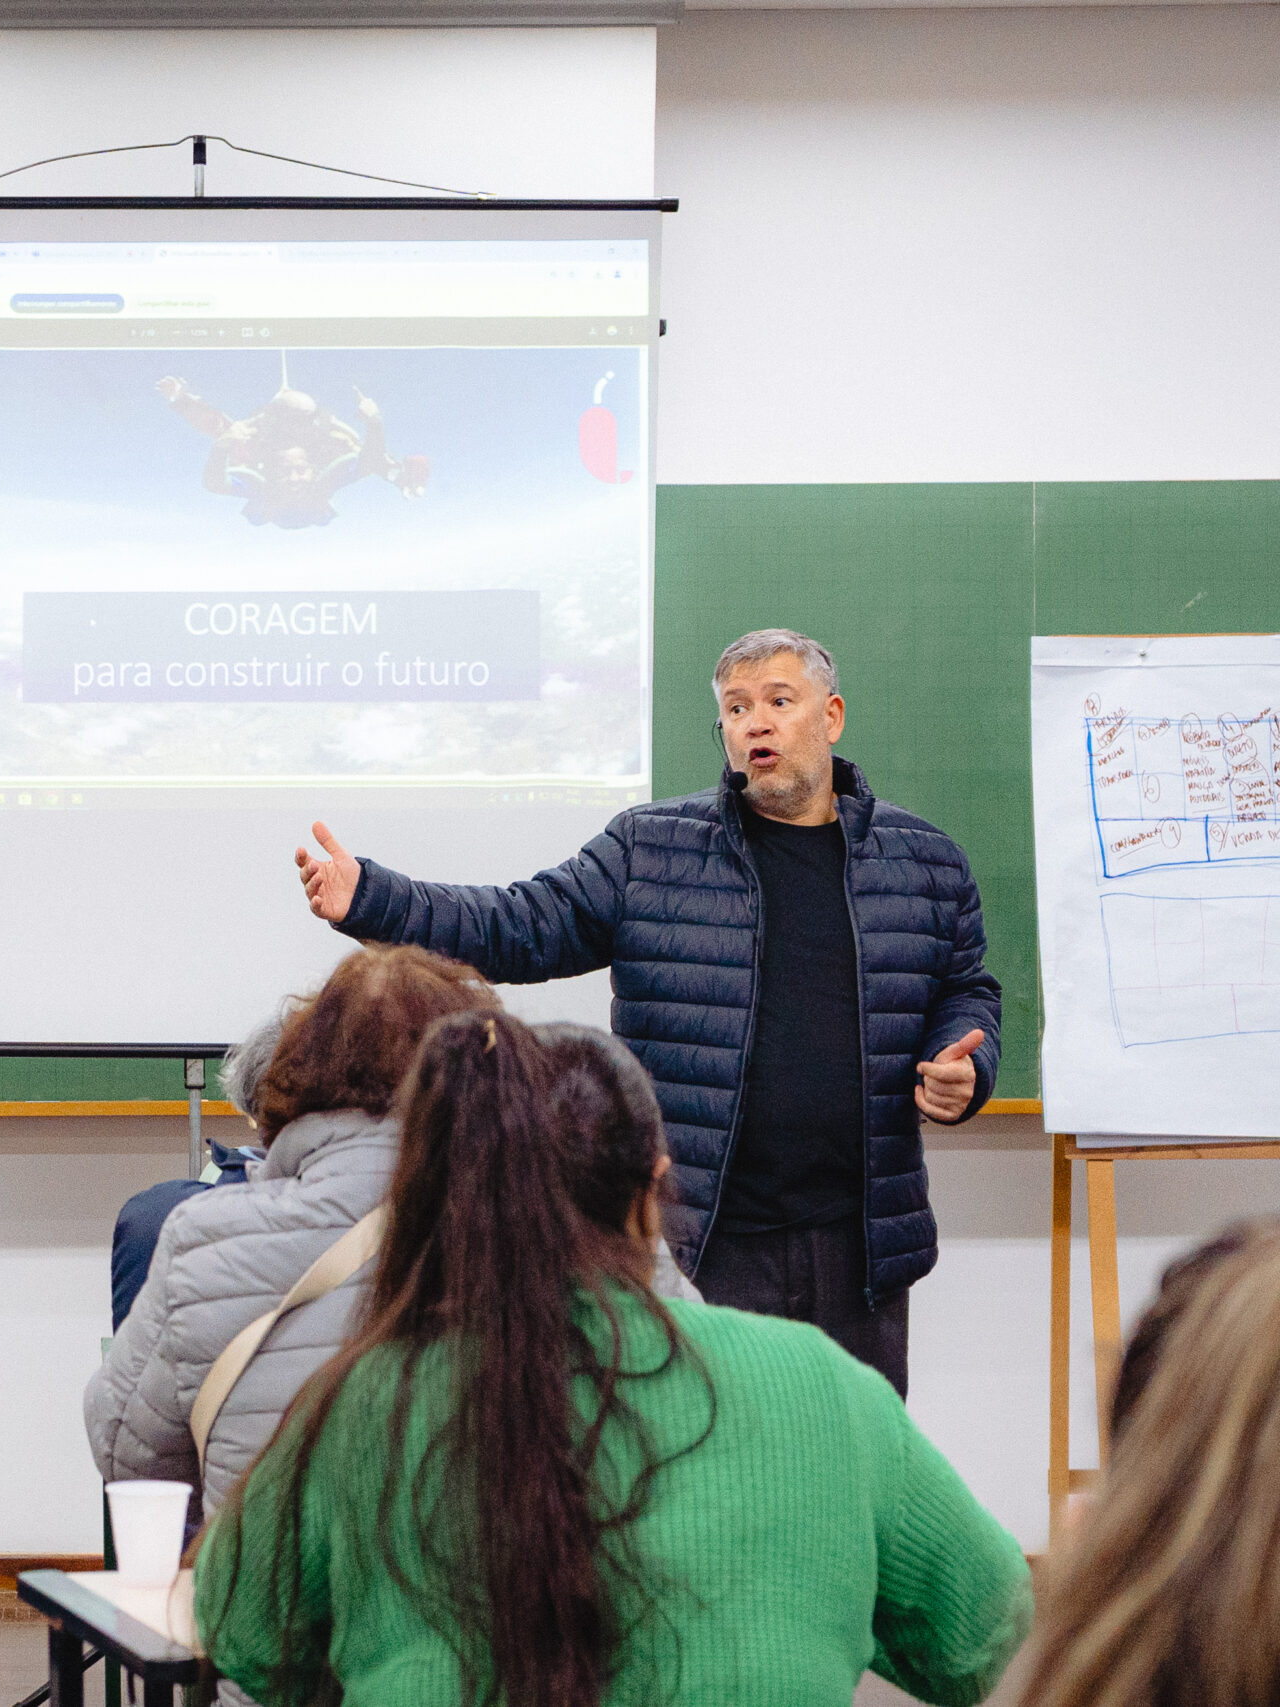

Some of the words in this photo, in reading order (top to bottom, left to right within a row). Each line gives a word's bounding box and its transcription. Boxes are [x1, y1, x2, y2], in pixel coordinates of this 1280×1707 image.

[184, 602, 377, 635] CORAGEM
[73, 661, 151, 695] para
[166, 652, 329, 687] construir
[341, 661, 364, 686] o
[375, 651, 490, 687] futuro
